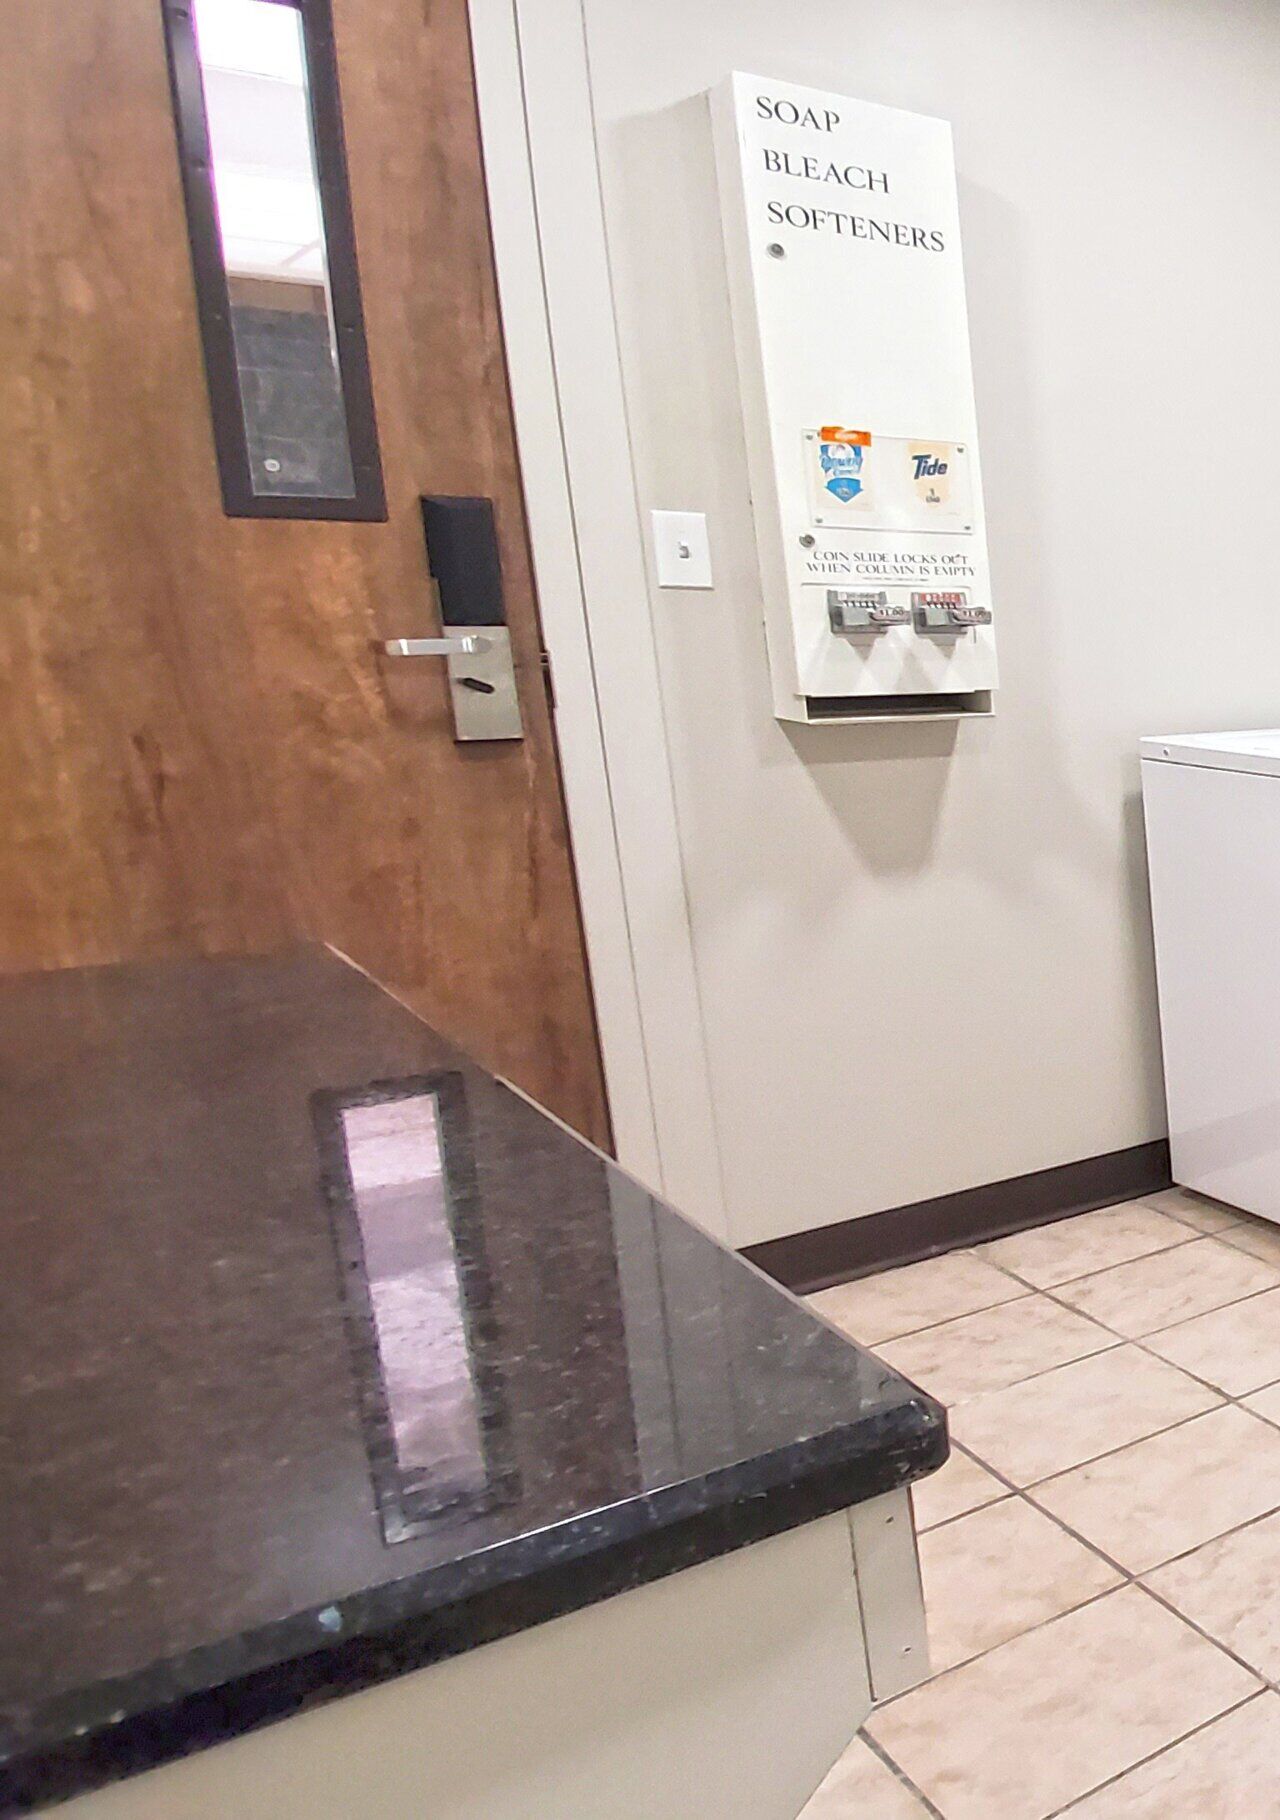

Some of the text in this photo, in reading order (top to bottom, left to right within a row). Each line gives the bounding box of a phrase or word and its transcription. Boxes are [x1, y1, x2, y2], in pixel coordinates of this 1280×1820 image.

[756, 96, 840, 133] SOAP
[762, 148, 890, 193] BLEACH
[766, 201, 945, 253] SOFTENERS
[911, 454, 948, 480] Tide
[806, 562, 977, 577] WHEN COLUMN IS EMPTY
[813, 551, 969, 565] COIN SLIDE LOCKS OUT
